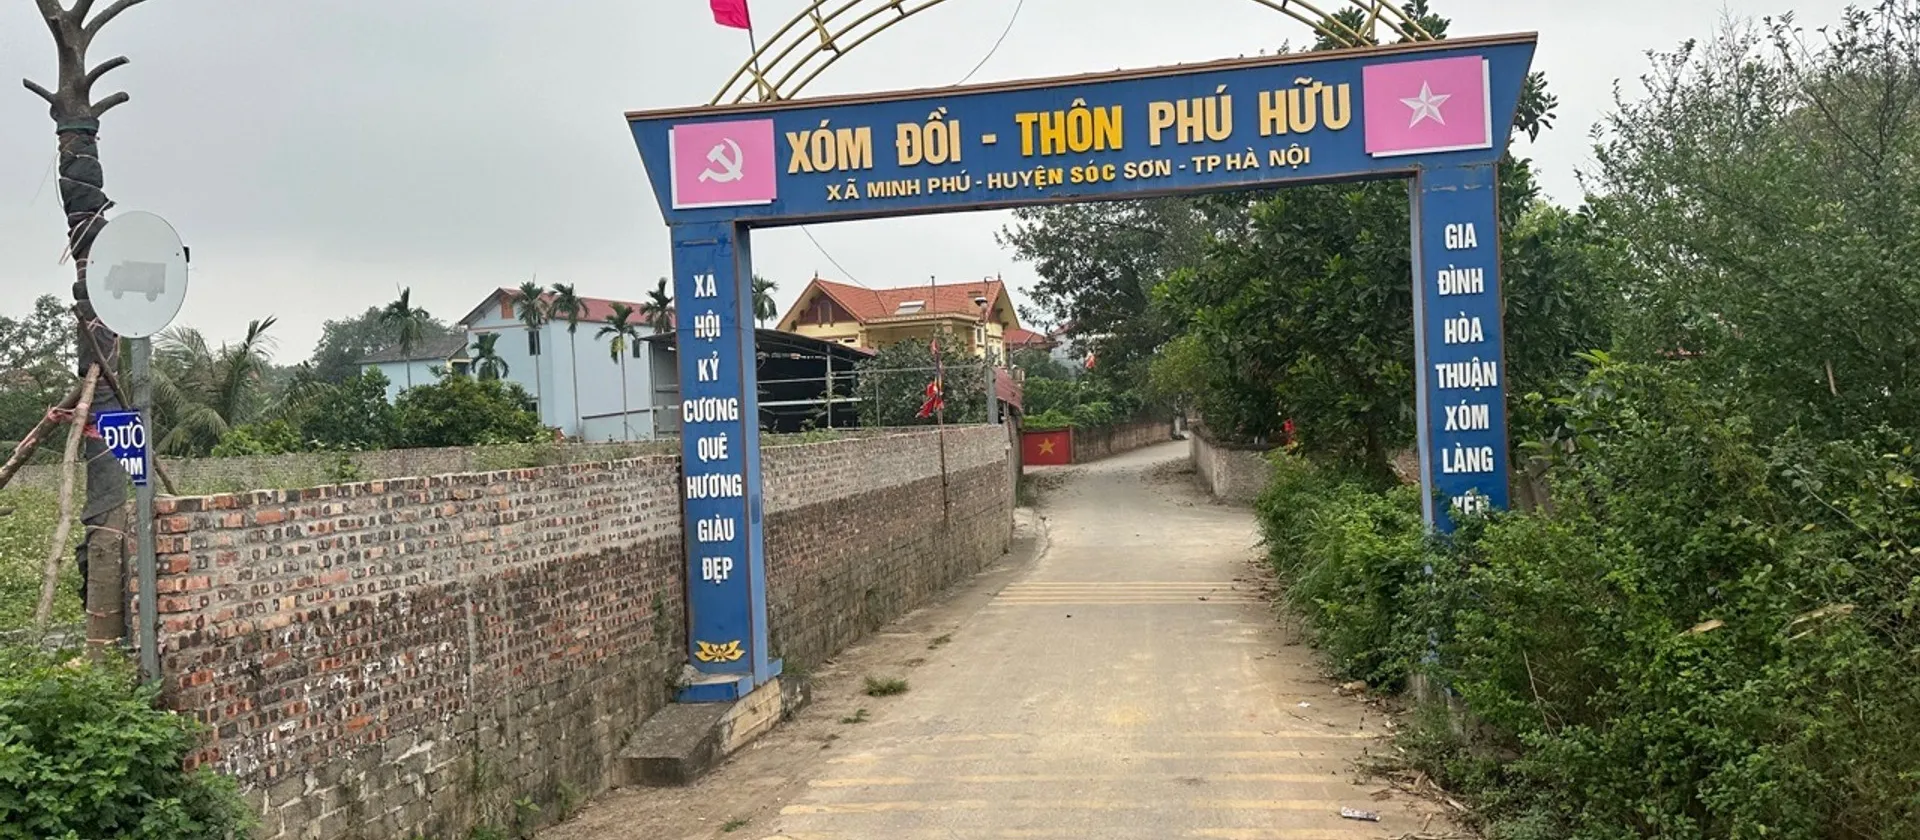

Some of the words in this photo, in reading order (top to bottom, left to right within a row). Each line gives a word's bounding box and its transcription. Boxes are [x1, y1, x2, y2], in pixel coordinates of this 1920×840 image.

[785, 119, 874, 174] XÓM
[896, 106, 961, 166] ĐỒI
[1015, 97, 1123, 156] THÔN
[1149, 84, 1233, 146] PHÚ
[1259, 76, 1351, 137] HỮU
[827, 178, 860, 201] XÃ
[867, 179, 921, 198] MINH
[928, 169, 971, 194] PHÚ
[988, 165, 1064, 190] HUYỆN
[1071, 159, 1116, 184] SÓC
[1124, 158, 1171, 180] SƠN
[1269, 143, 1311, 169] NỘI
[1444, 223, 1478, 250] GIA
[1438, 264, 1484, 295] ĐÌNH
[694, 309, 721, 342] HỘI
[1444, 311, 1484, 344] HÒA
[698, 351, 720, 382] KỶ
[1435, 356, 1498, 392] THUẬN
[683, 396, 739, 423] CƯƠNG
[1444, 399, 1490, 431] XÓM
[697, 432, 729, 463] QUÊ
[1442, 442, 1494, 473] LÀNG
[686, 473, 743, 499] HƯƠNG
[697, 514, 735, 542] GIÀU
[702, 556, 733, 584] ĐẸP
